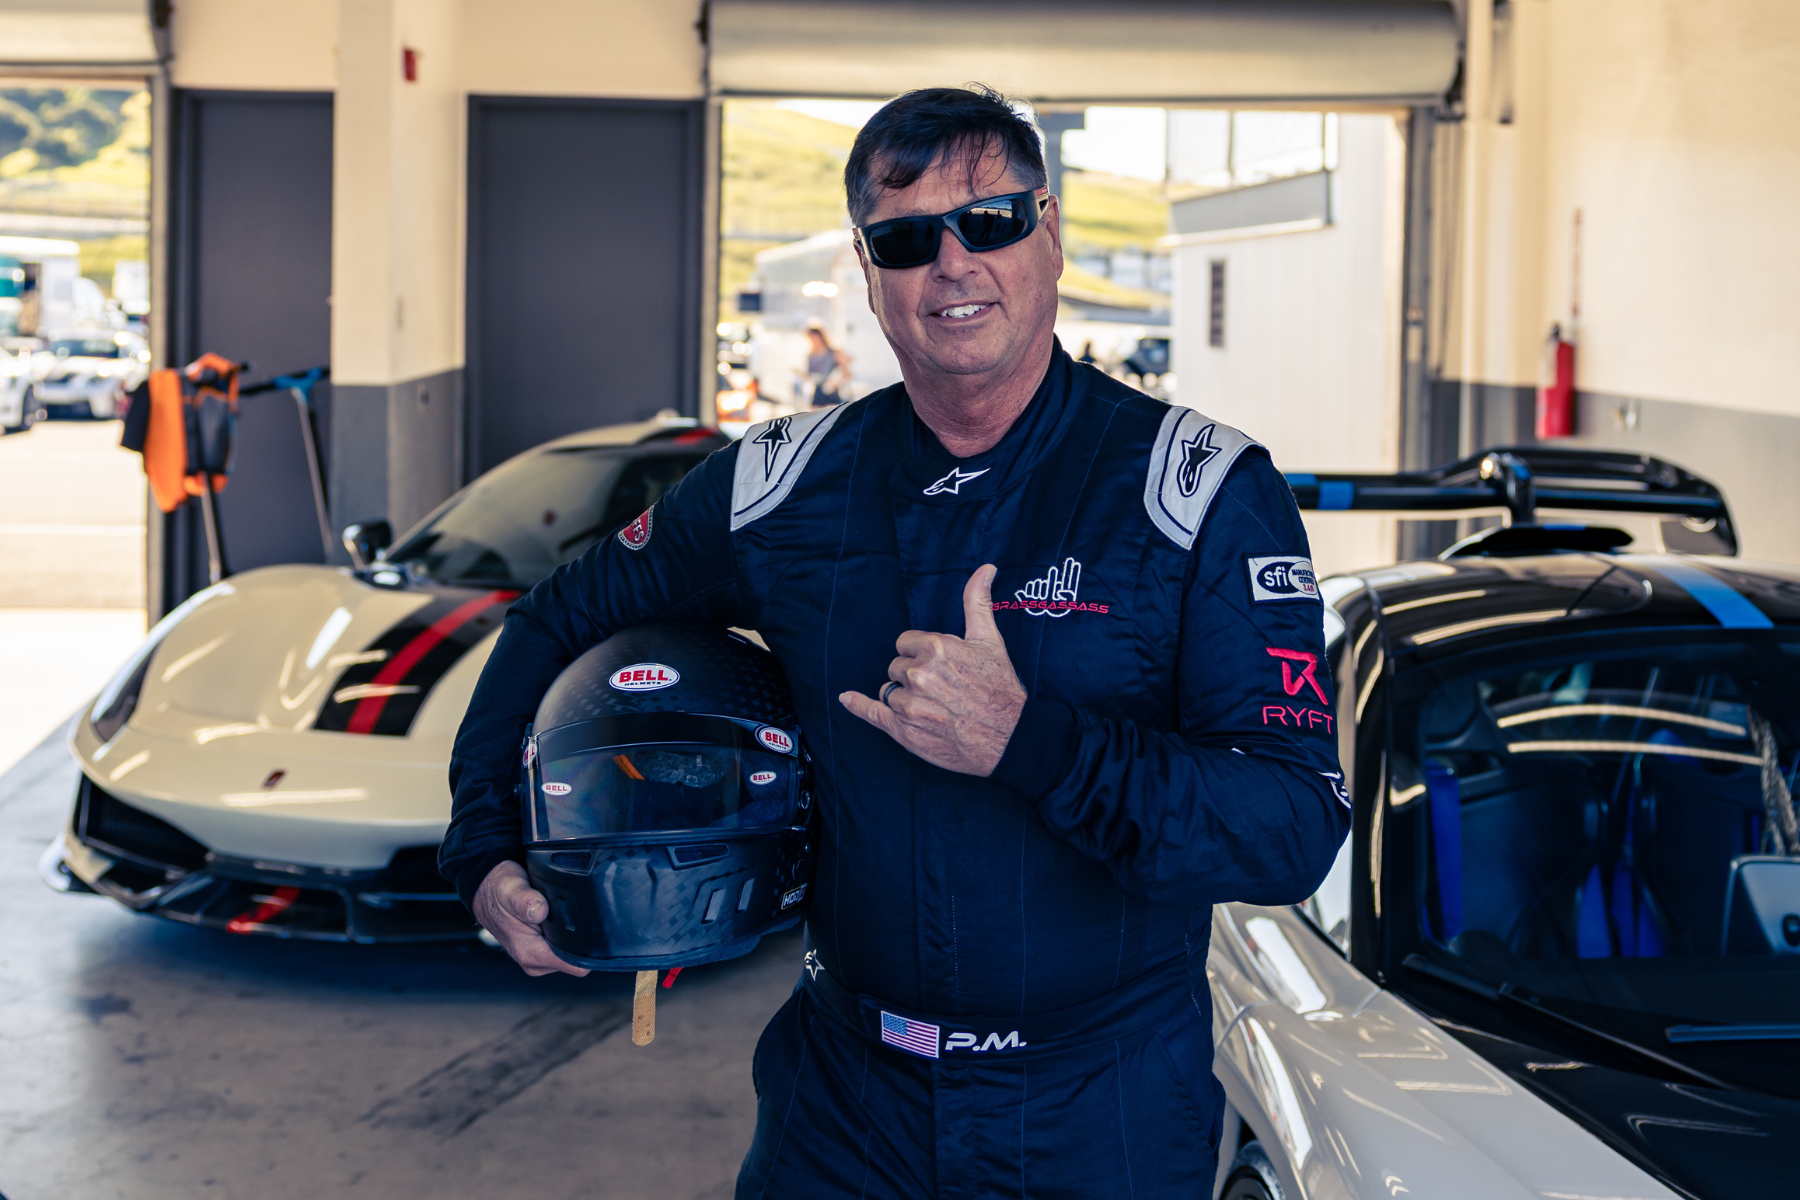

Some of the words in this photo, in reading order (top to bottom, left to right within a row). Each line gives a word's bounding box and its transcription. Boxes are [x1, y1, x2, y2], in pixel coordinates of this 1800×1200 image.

[1263, 565, 1289, 588] sfi
[618, 669, 669, 684] BELL
[1262, 705, 1334, 735] RYFT
[765, 731, 790, 748] BELL
[752, 773, 773, 782] BELL
[545, 784, 569, 792] BELL
[944, 1030, 1028, 1052] P.M.
